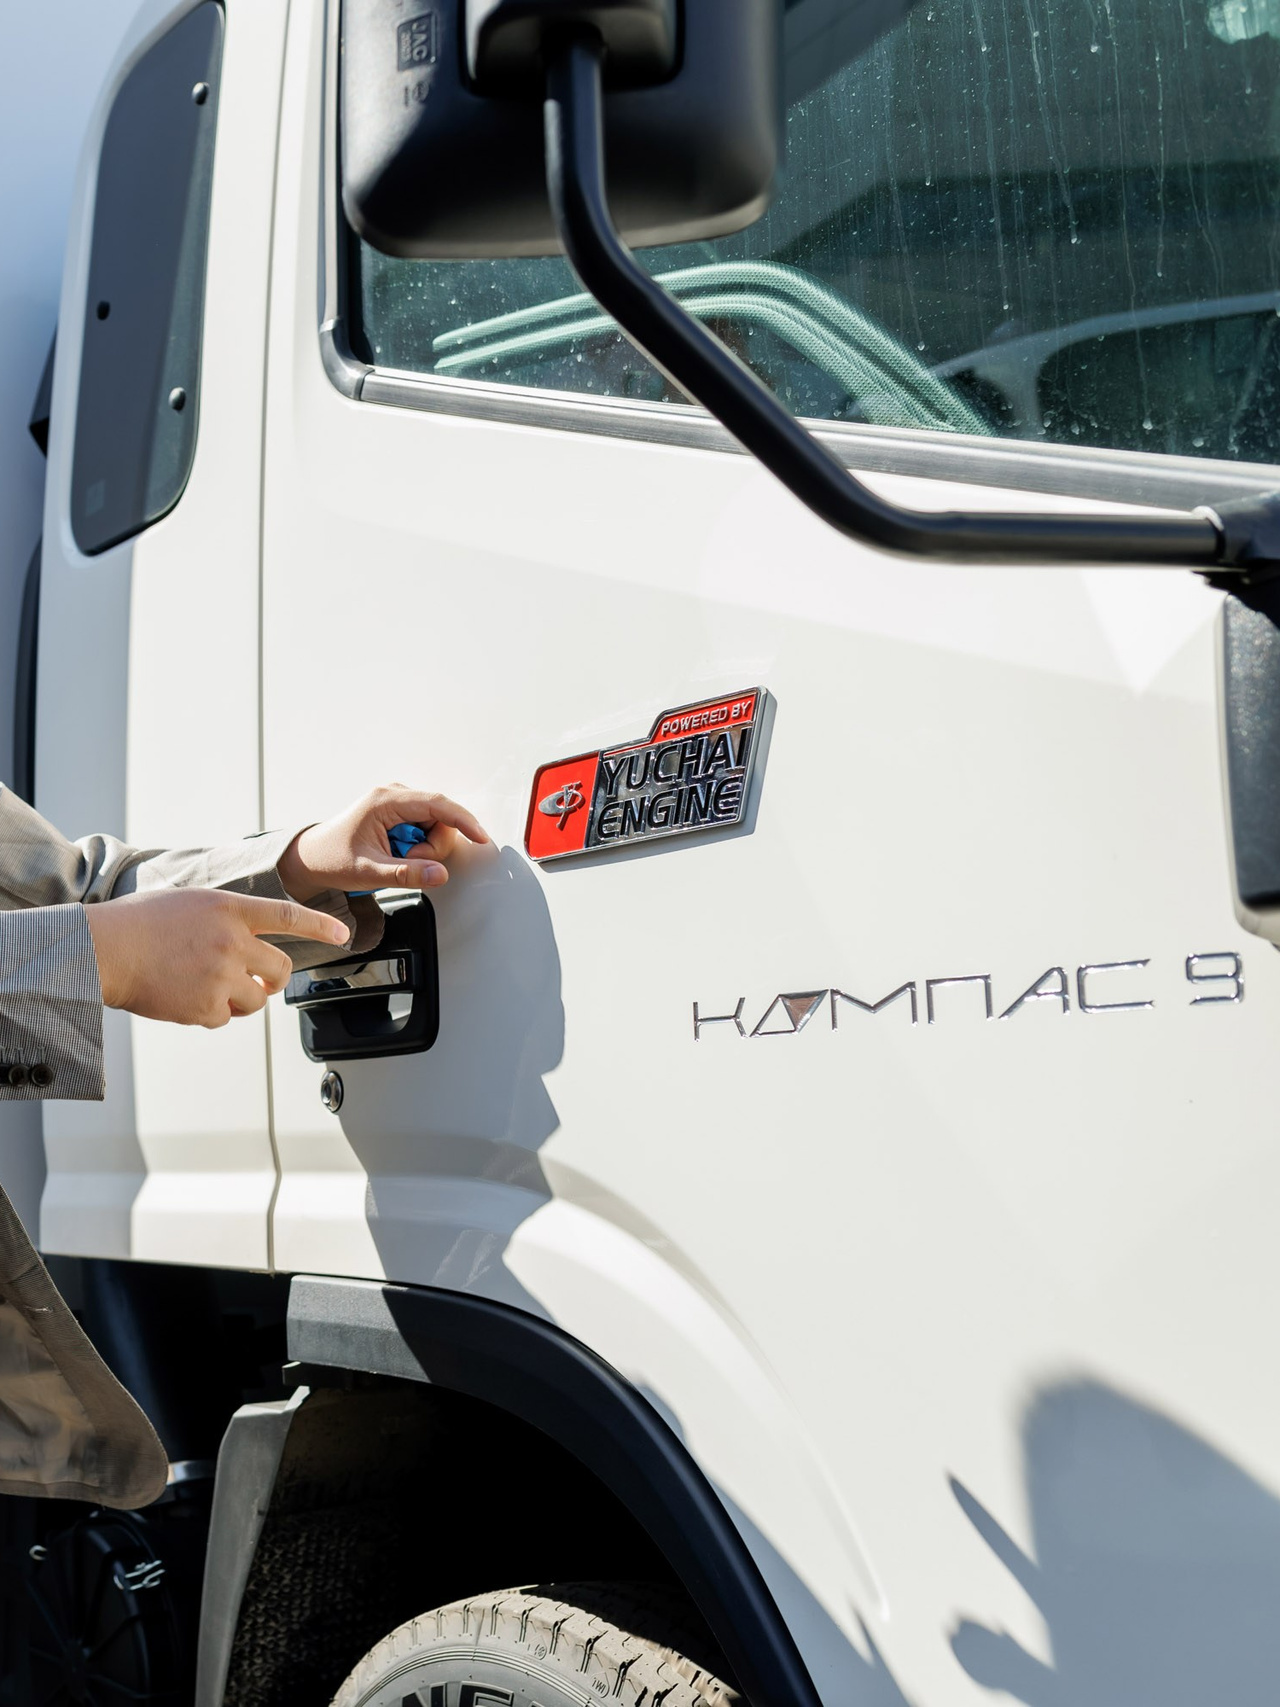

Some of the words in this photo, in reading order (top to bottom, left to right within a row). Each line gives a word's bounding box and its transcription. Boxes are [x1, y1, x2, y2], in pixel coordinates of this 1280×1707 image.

[661, 706, 728, 737] POWERED
[732, 700, 752, 719] BY
[602, 725, 754, 798] YUCHAI
[597, 773, 743, 841] ENGINE
[1185, 950, 1245, 1006] 9
